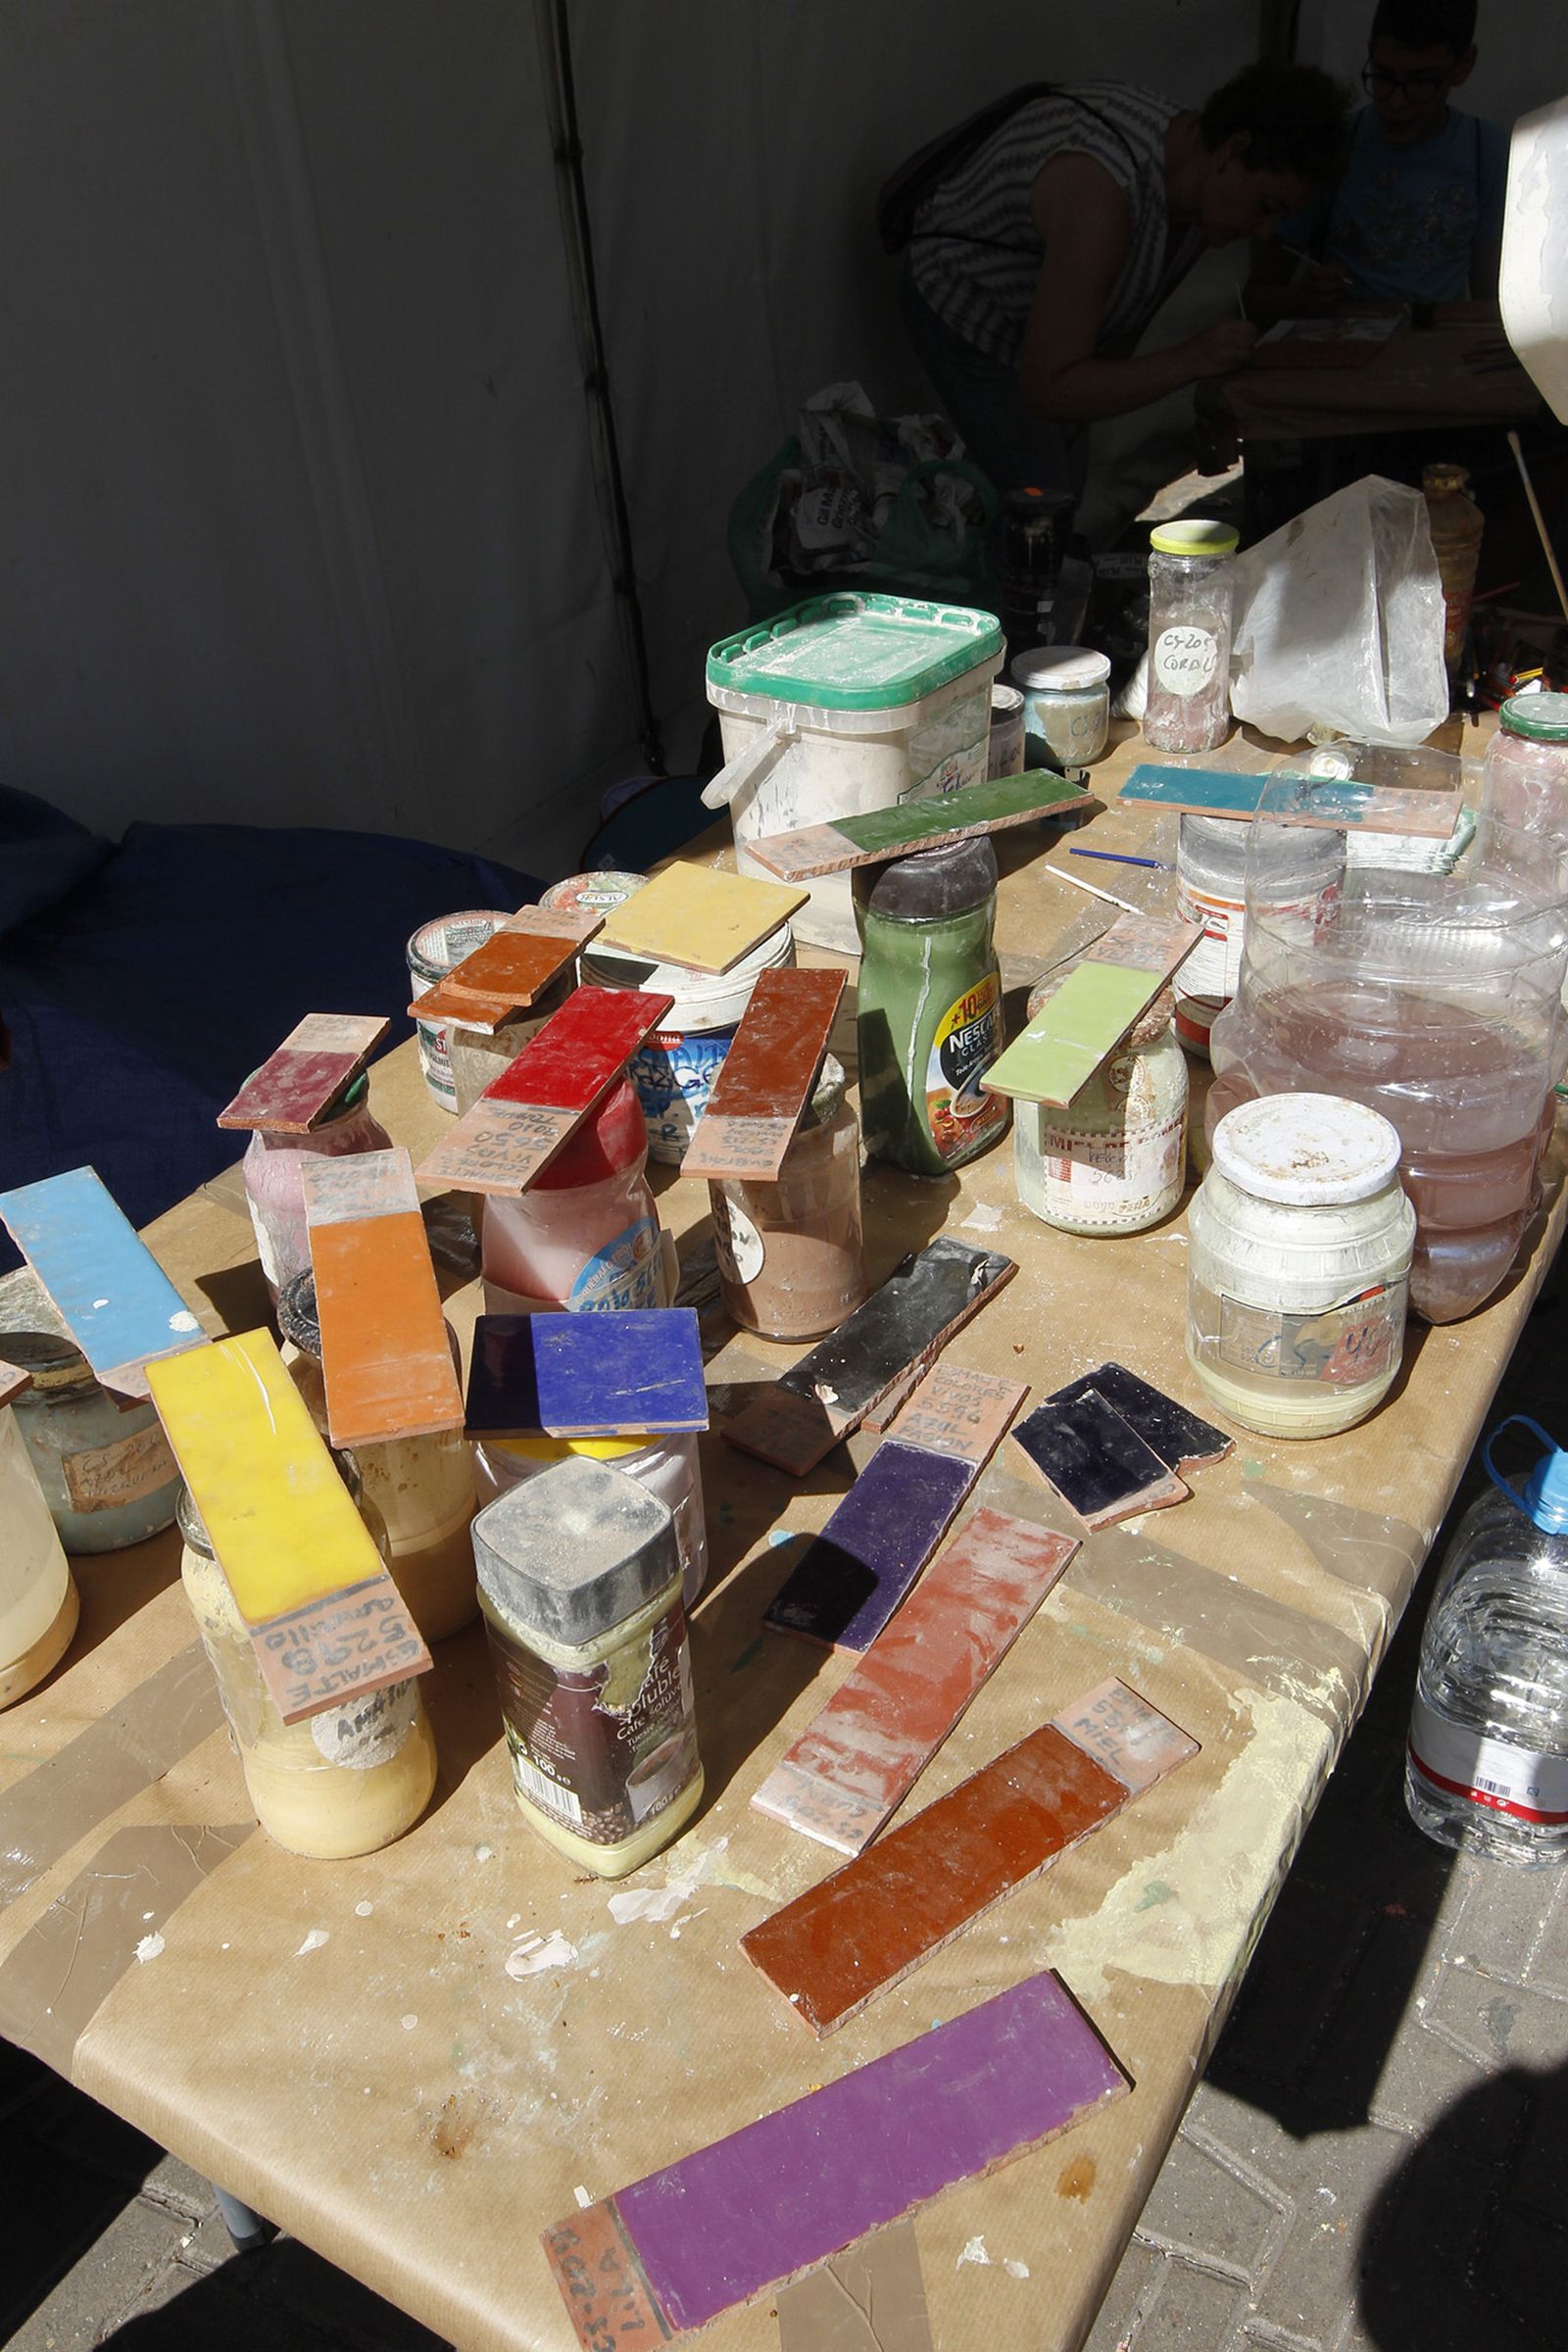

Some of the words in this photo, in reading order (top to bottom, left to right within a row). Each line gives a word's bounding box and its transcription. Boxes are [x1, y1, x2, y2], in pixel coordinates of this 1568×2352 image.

[1163, 656, 1217, 672] CORAL
[281, 1615, 407, 1676] 5298
[285, 1639, 419, 1706] ESMALTE
[532, 1754, 556, 1777] 100
[1073, 1717, 1123, 1765] MIEL
[598, 2245, 646, 2332] LILA
